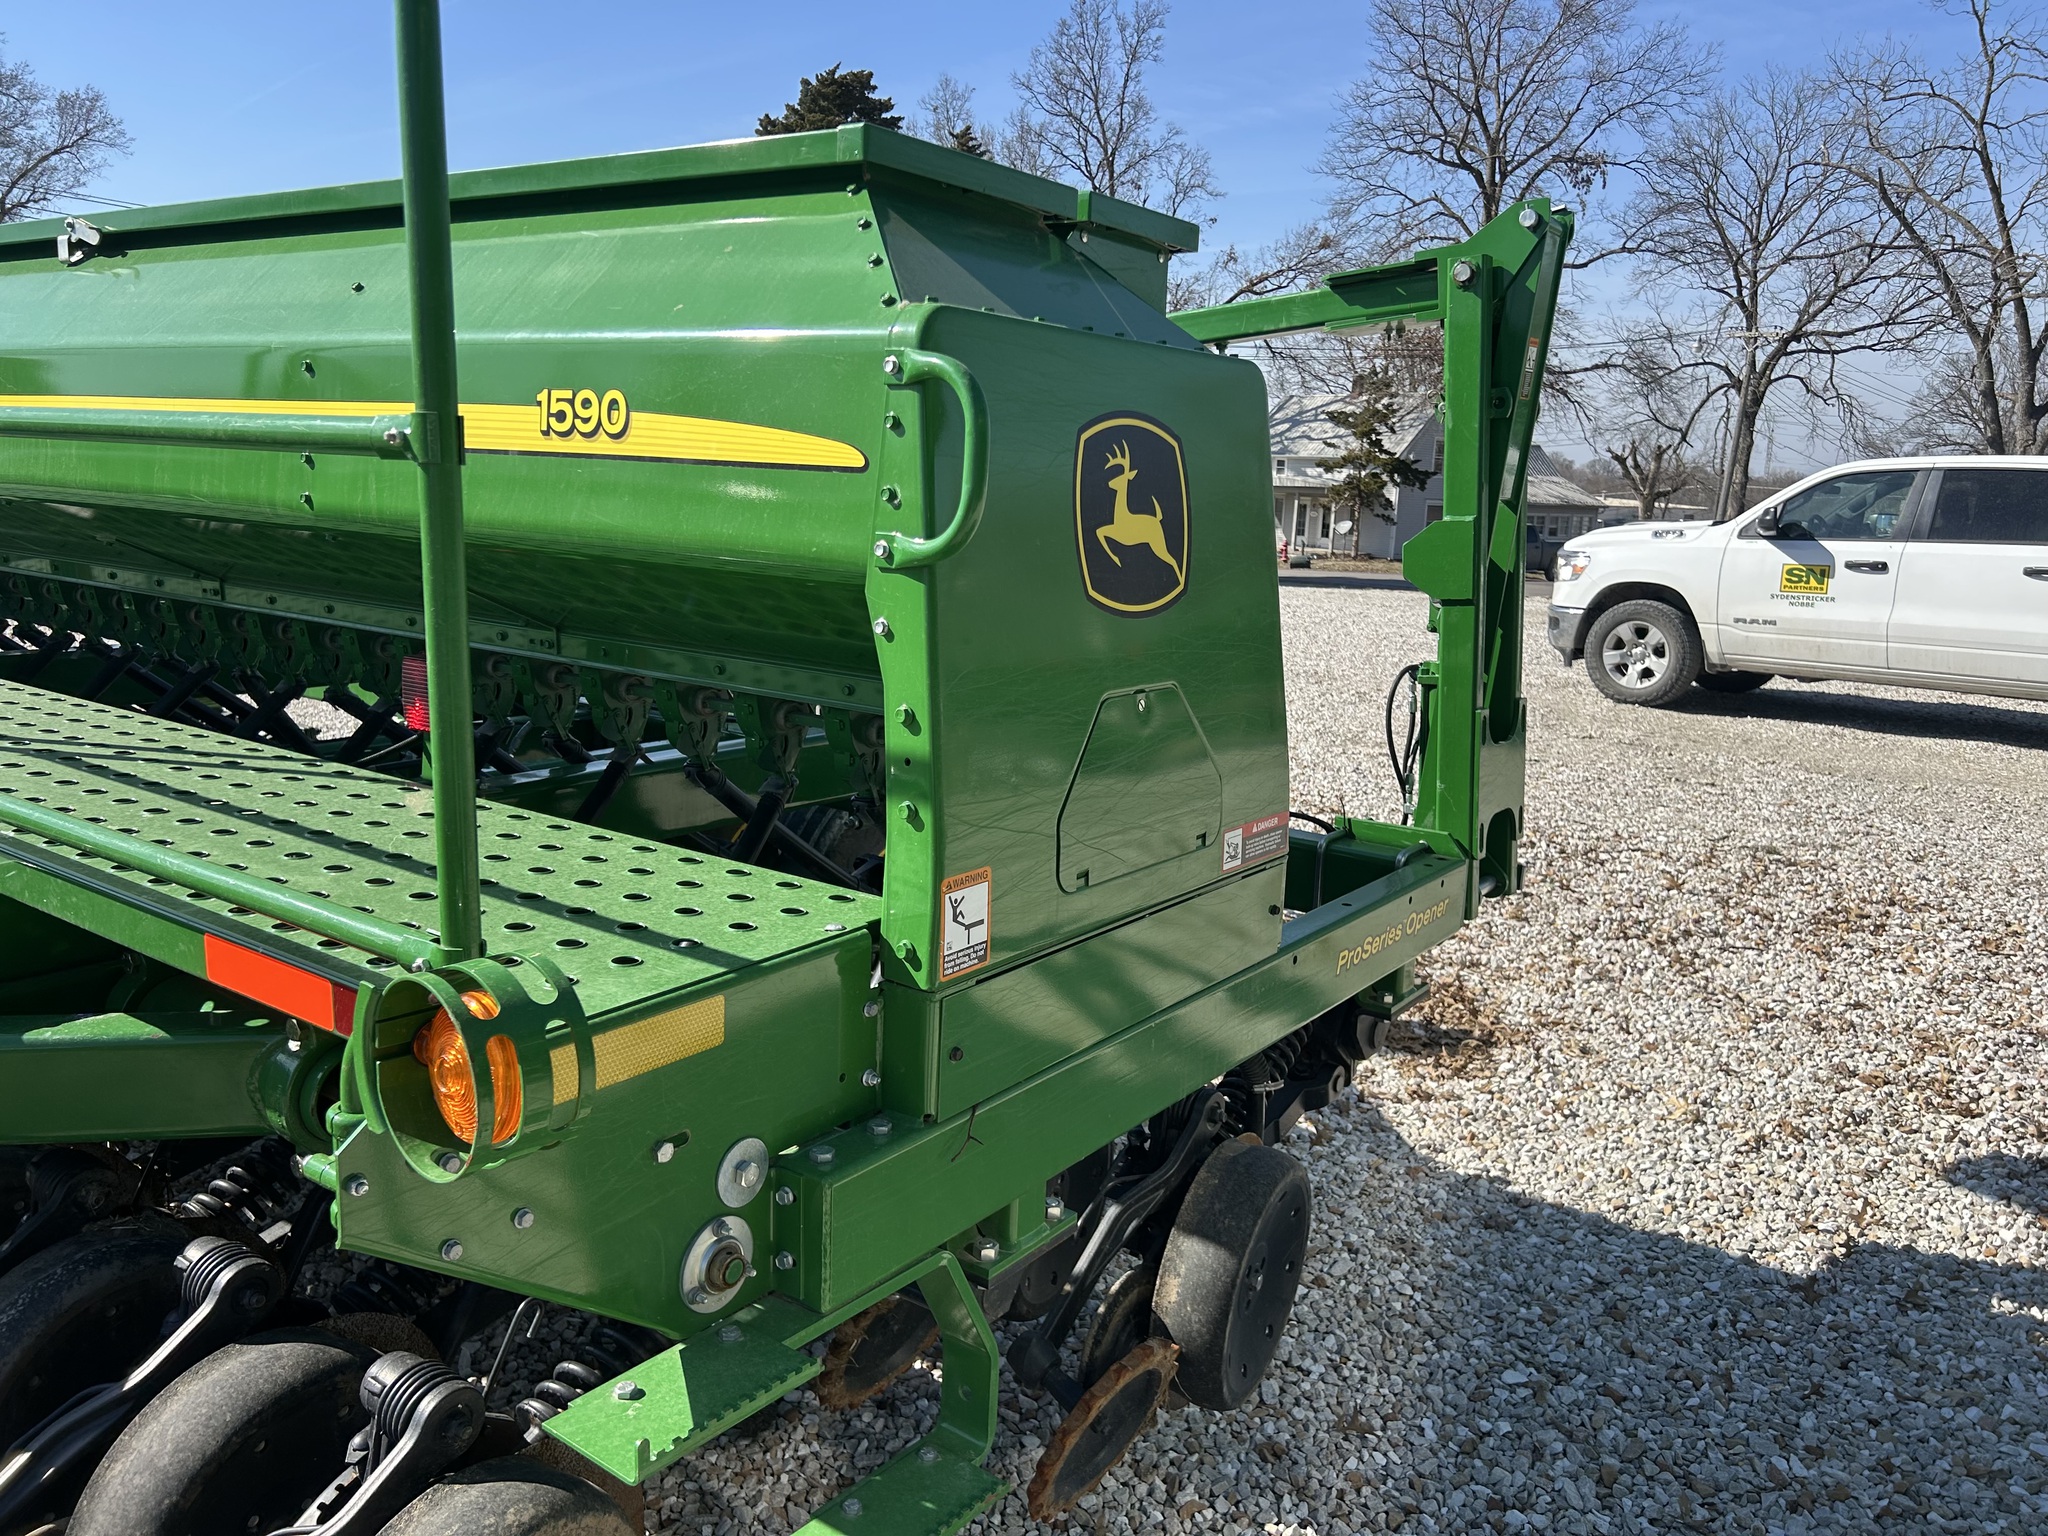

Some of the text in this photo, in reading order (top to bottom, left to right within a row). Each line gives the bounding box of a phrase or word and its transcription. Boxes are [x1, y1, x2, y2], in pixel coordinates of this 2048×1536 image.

[536, 388, 629, 441] 1590
[1769, 593, 1836, 603] SYDENSTRICKER
[1733, 617, 1777, 626] RAM
[1257, 817, 1279, 831] DANGER
[952, 869, 989, 889] WARNING
[1406, 897, 1450, 935] Opener
